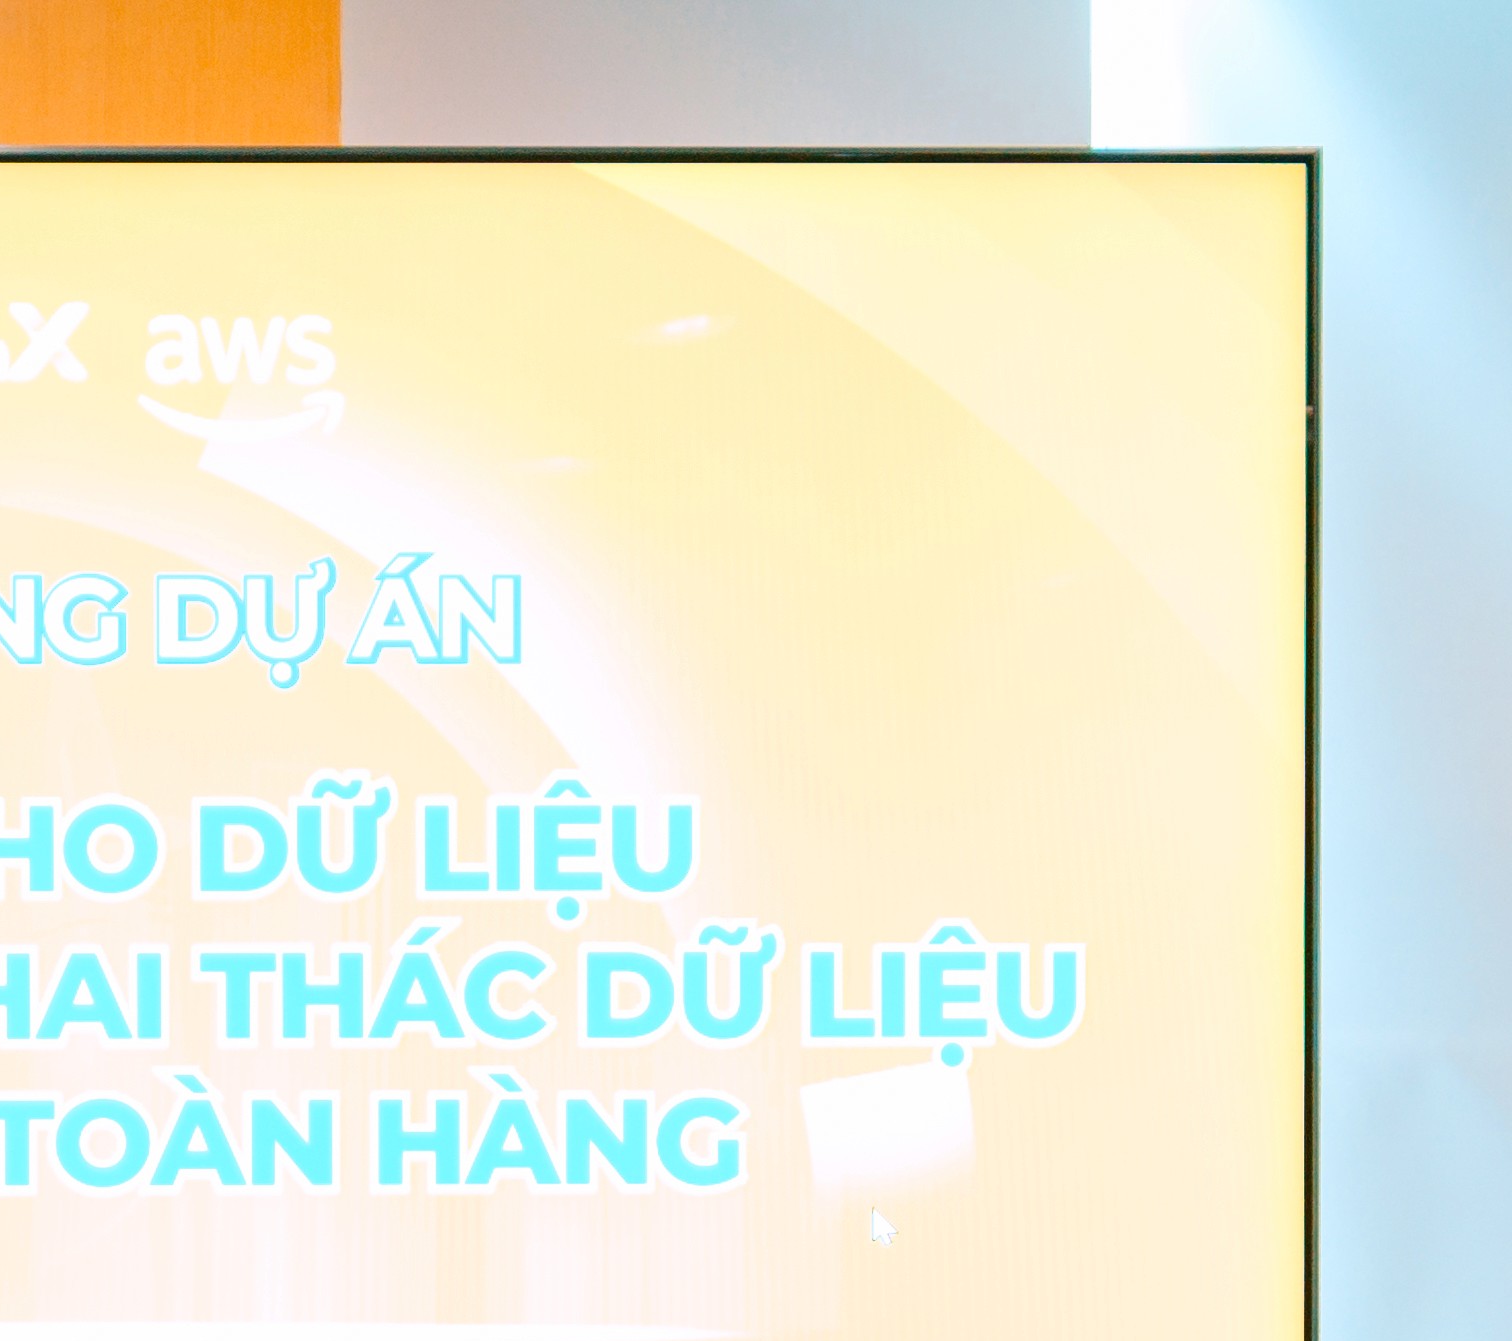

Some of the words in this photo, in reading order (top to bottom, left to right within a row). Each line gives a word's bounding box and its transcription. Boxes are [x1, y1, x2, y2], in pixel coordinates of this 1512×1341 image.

[145, 312, 337, 388] aws
[156, 555, 337, 690] DỰ
[346, 551, 522, 666] ÁN
[199, 777, 392, 894] DỮ
[424, 778, 693, 922] LIỆU
[199, 925, 547, 1041] THÁC
[583, 925, 778, 1041] DỮ
[809, 925, 1077, 1068] LIỆU
[377, 1073, 740, 1188] HÀNG
